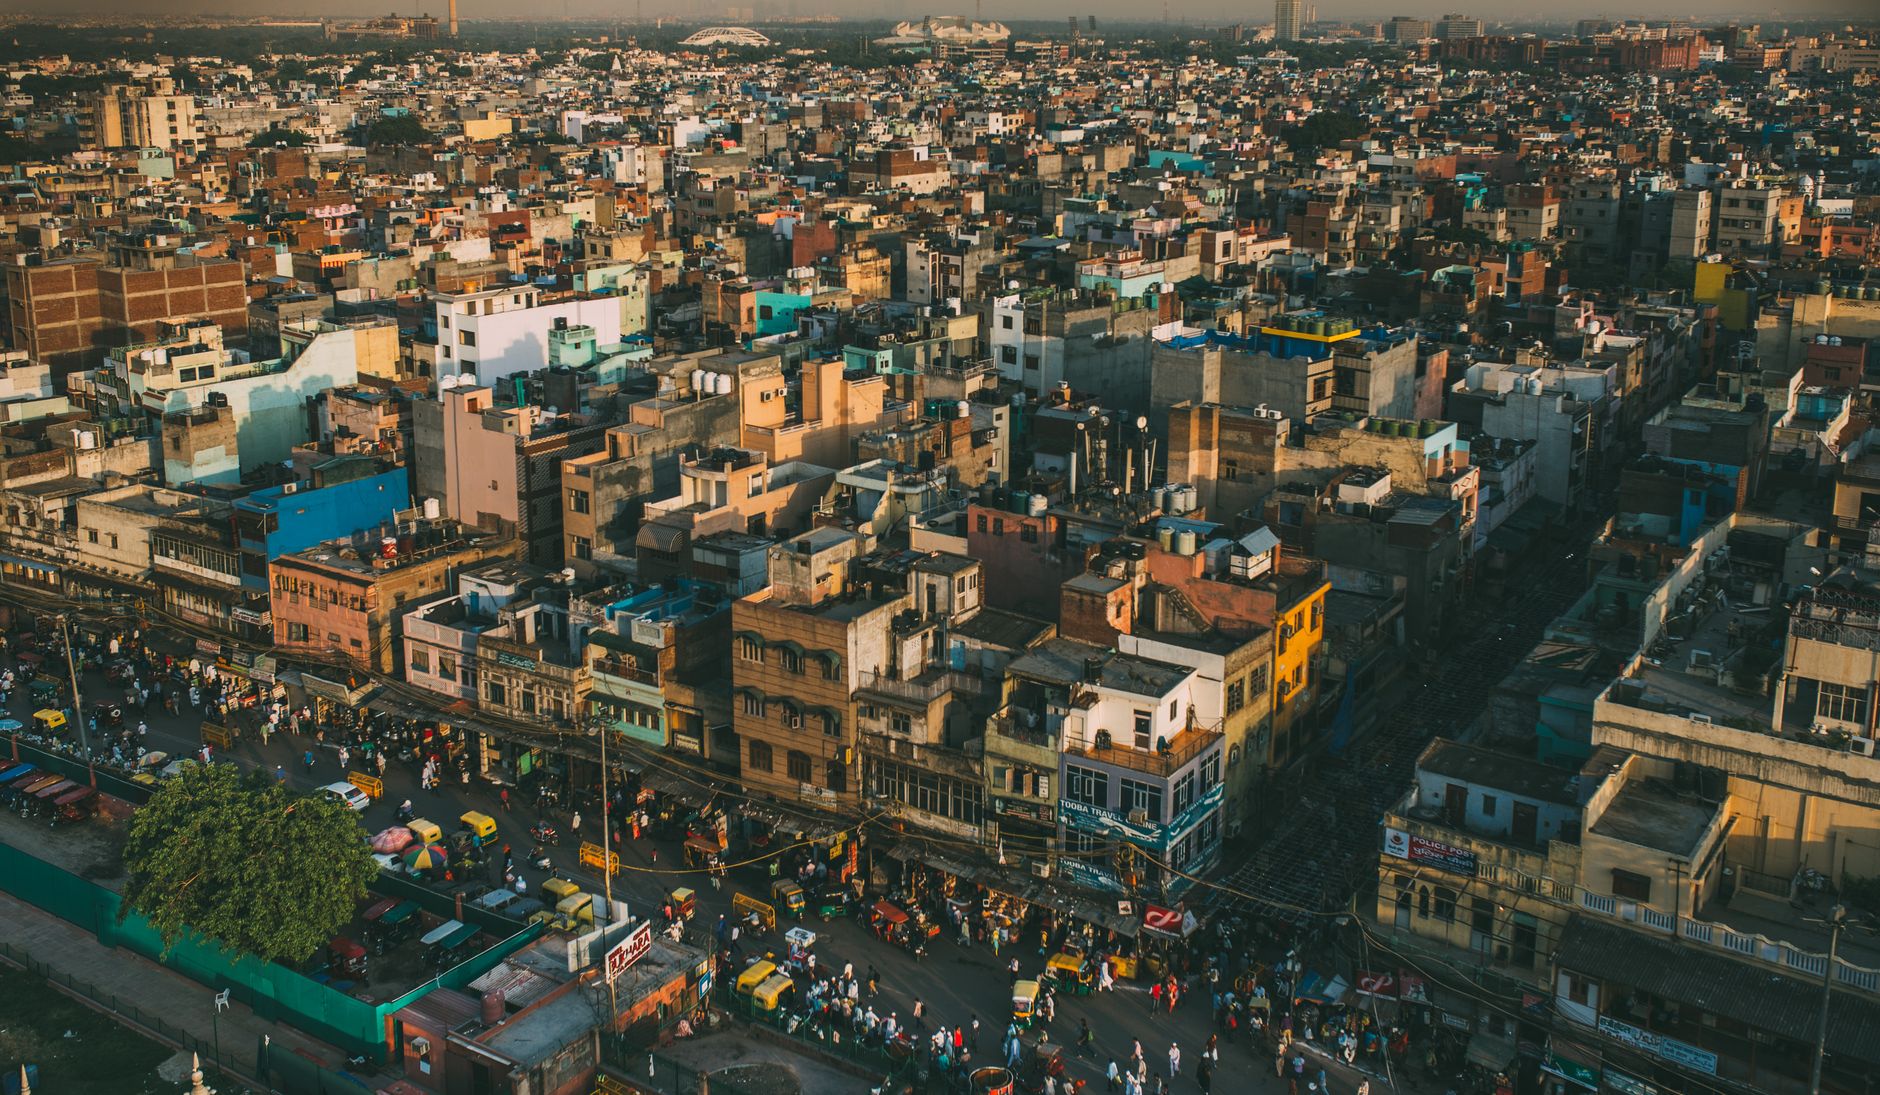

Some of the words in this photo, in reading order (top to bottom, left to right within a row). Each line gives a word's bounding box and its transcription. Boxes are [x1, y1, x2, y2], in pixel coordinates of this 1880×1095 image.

[1060, 800, 1089, 813] TOOBA
[1091, 806, 1122, 822] TRAVEL
[1413, 836, 1447, 850] POLICE
[1450, 847, 1474, 859] POST
[1060, 857, 1087, 871] TOOBA
